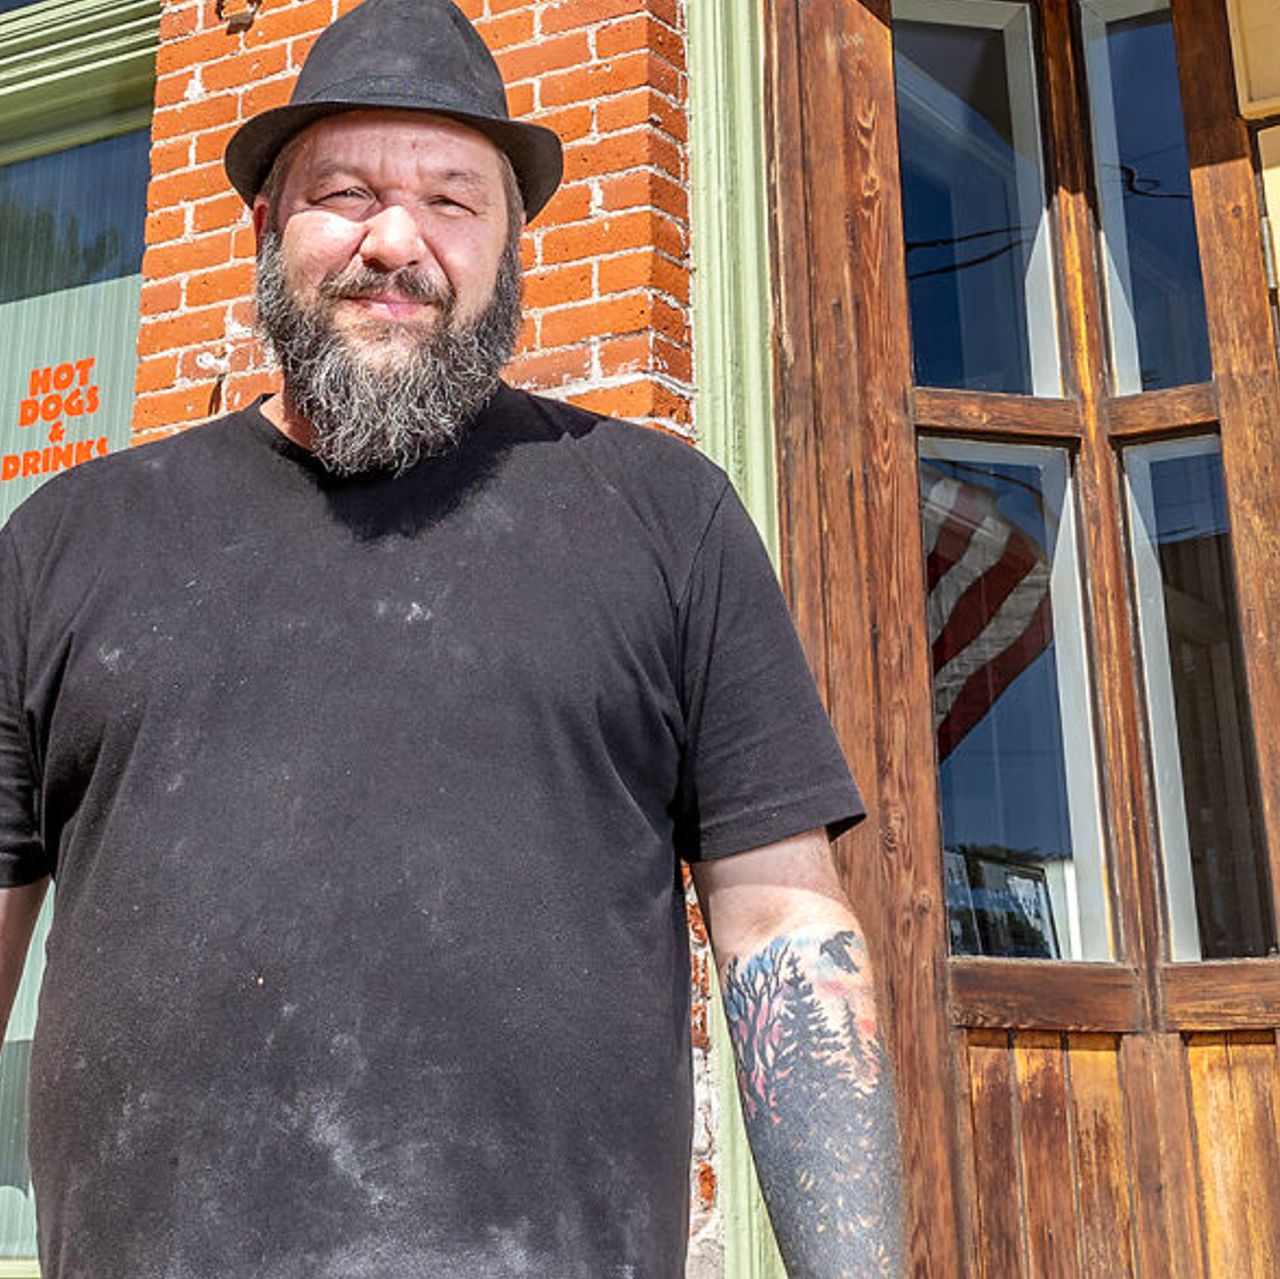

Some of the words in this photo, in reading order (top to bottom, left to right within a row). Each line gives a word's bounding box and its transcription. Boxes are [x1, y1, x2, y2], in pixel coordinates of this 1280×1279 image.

[28, 357, 96, 397] HOT
[18, 385, 100, 427] DOGS
[48, 420, 66, 444] &
[0, 436, 110, 482] DRINKS
